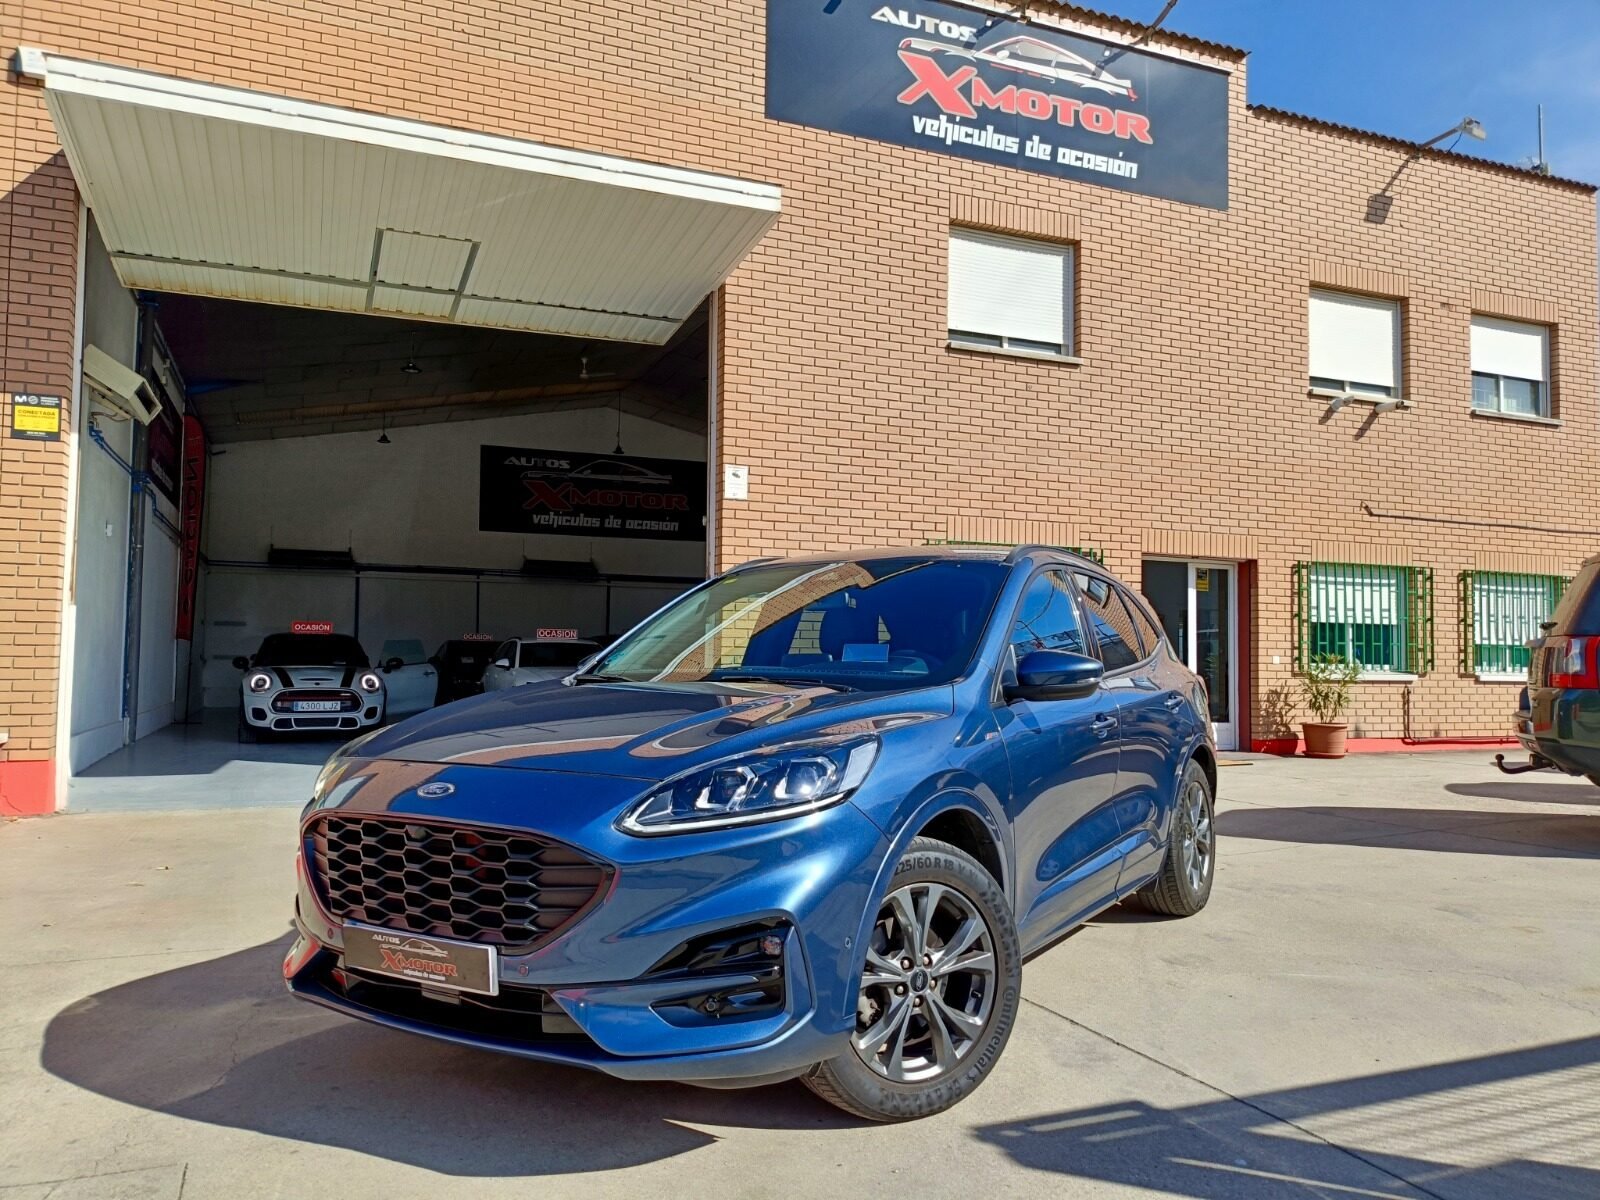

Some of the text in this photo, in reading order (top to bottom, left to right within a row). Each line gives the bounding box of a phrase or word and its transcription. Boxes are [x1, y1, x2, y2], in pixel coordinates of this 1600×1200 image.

[871, 6, 976, 42] AUTOS
[912, 114, 1138, 179] vehículos de ocasión
[503, 456, 571, 469] AUTOS
[604, 514, 622, 529] de
[625, 516, 679, 531] ocasión
[300, 702, 339, 710] 4300 LJZ
[934, 857, 942, 869] R
[372, 934, 401, 944] AUTOS
[976, 986, 1016, 1075] Continental
